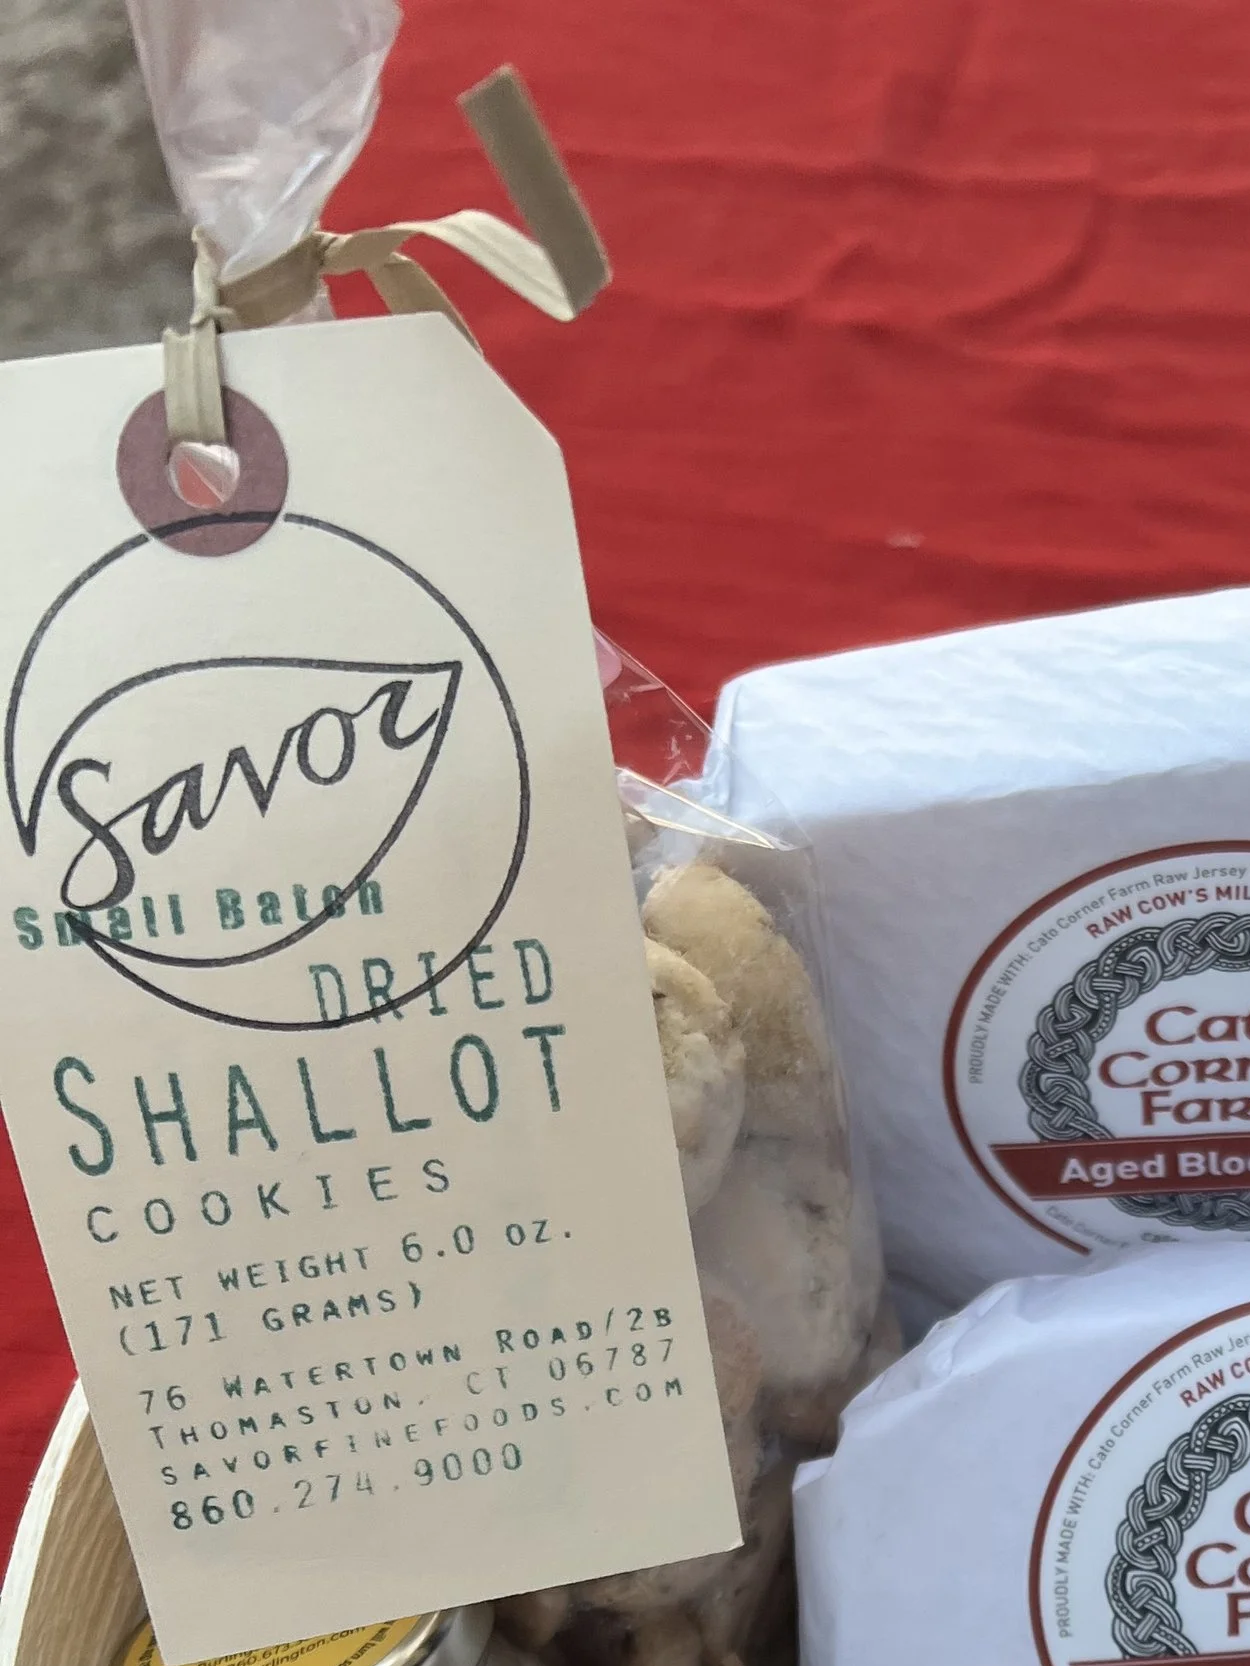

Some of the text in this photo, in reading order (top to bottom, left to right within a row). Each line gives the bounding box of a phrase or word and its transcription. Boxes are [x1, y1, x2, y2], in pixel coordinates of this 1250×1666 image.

[57, 679, 439, 912] Savor
[1086, 905, 1134, 939] RAW
[1138, 887, 1209, 914] COW'S
[309, 939, 554, 1024] DRIED
[967, 1024, 988, 1085] PROUDLY
[979, 979, 1008, 1024] MADE
[1027, 928, 1059, 953] Cato
[1056, 894, 1106, 929] Corner
[1107, 880, 1151, 902] Farm
[1153, 869, 1188, 888] Raw
[1192, 865, 1247, 881] Jersey
[53, 1024, 565, 1176] SHALLOT
[86, 1159, 451, 1244] COOKIES
[1060, 1151, 1165, 1189] Aged
[109, 1275, 185, 1310] NET
[218, 1246, 371, 1291] WEIGHT
[401, 1224, 476, 1263] 6.0
[119, 1280, 423, 1357] (171 GRAMS)
[1191, 1344, 1225, 1367] Raw
[139, 1306, 673, 1416] 76 WATERTOWN ROAD/2B
[467, 1365, 511, 1396] CT
[550, 1339, 675, 1384] 06787
[1152, 1364, 1193, 1396] Farm
[1179, 1369, 1227, 1409] RAW
[160, 1376, 684, 1486] SAVORFINEFOODS.COM
[1110, 1391, 1155, 1438] Corner
[171, 1441, 523, 1532] 860.274.9000
[1088, 1438, 1117, 1471] Cato
[1066, 1469, 1096, 1515] WITH:
[1058, 1513, 1077, 1568] MADE
[1052, 1566, 1073, 1640] PROUDLY
